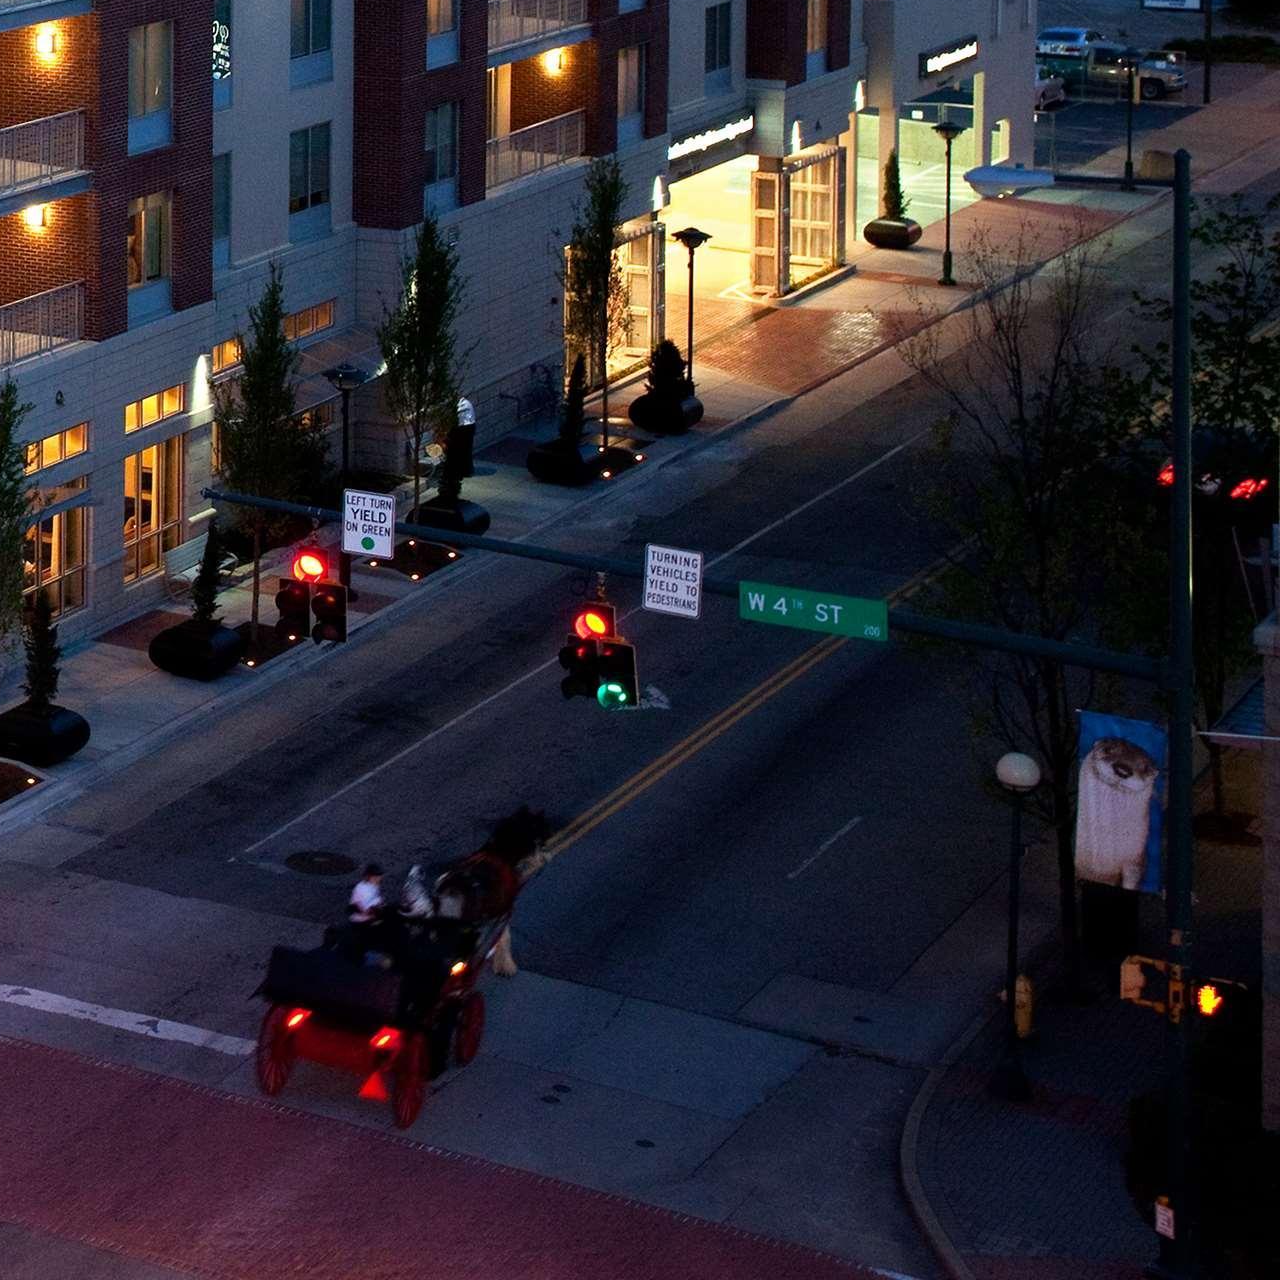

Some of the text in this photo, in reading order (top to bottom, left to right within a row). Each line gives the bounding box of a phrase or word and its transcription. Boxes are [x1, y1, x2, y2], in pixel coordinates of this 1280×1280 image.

[346, 495, 391, 510] LEFT TURN
[351, 507, 387, 524] YIELD
[346, 521, 391, 536] ON GREEN
[651, 551, 698, 569] TURNING
[650, 565, 697, 583] VEHICLES
[649, 579, 697, 597] YIELD TO
[647, 592, 697, 611] PEDESTRIANS
[748, 592, 765, 612] W
[815, 603, 843, 624] ST
